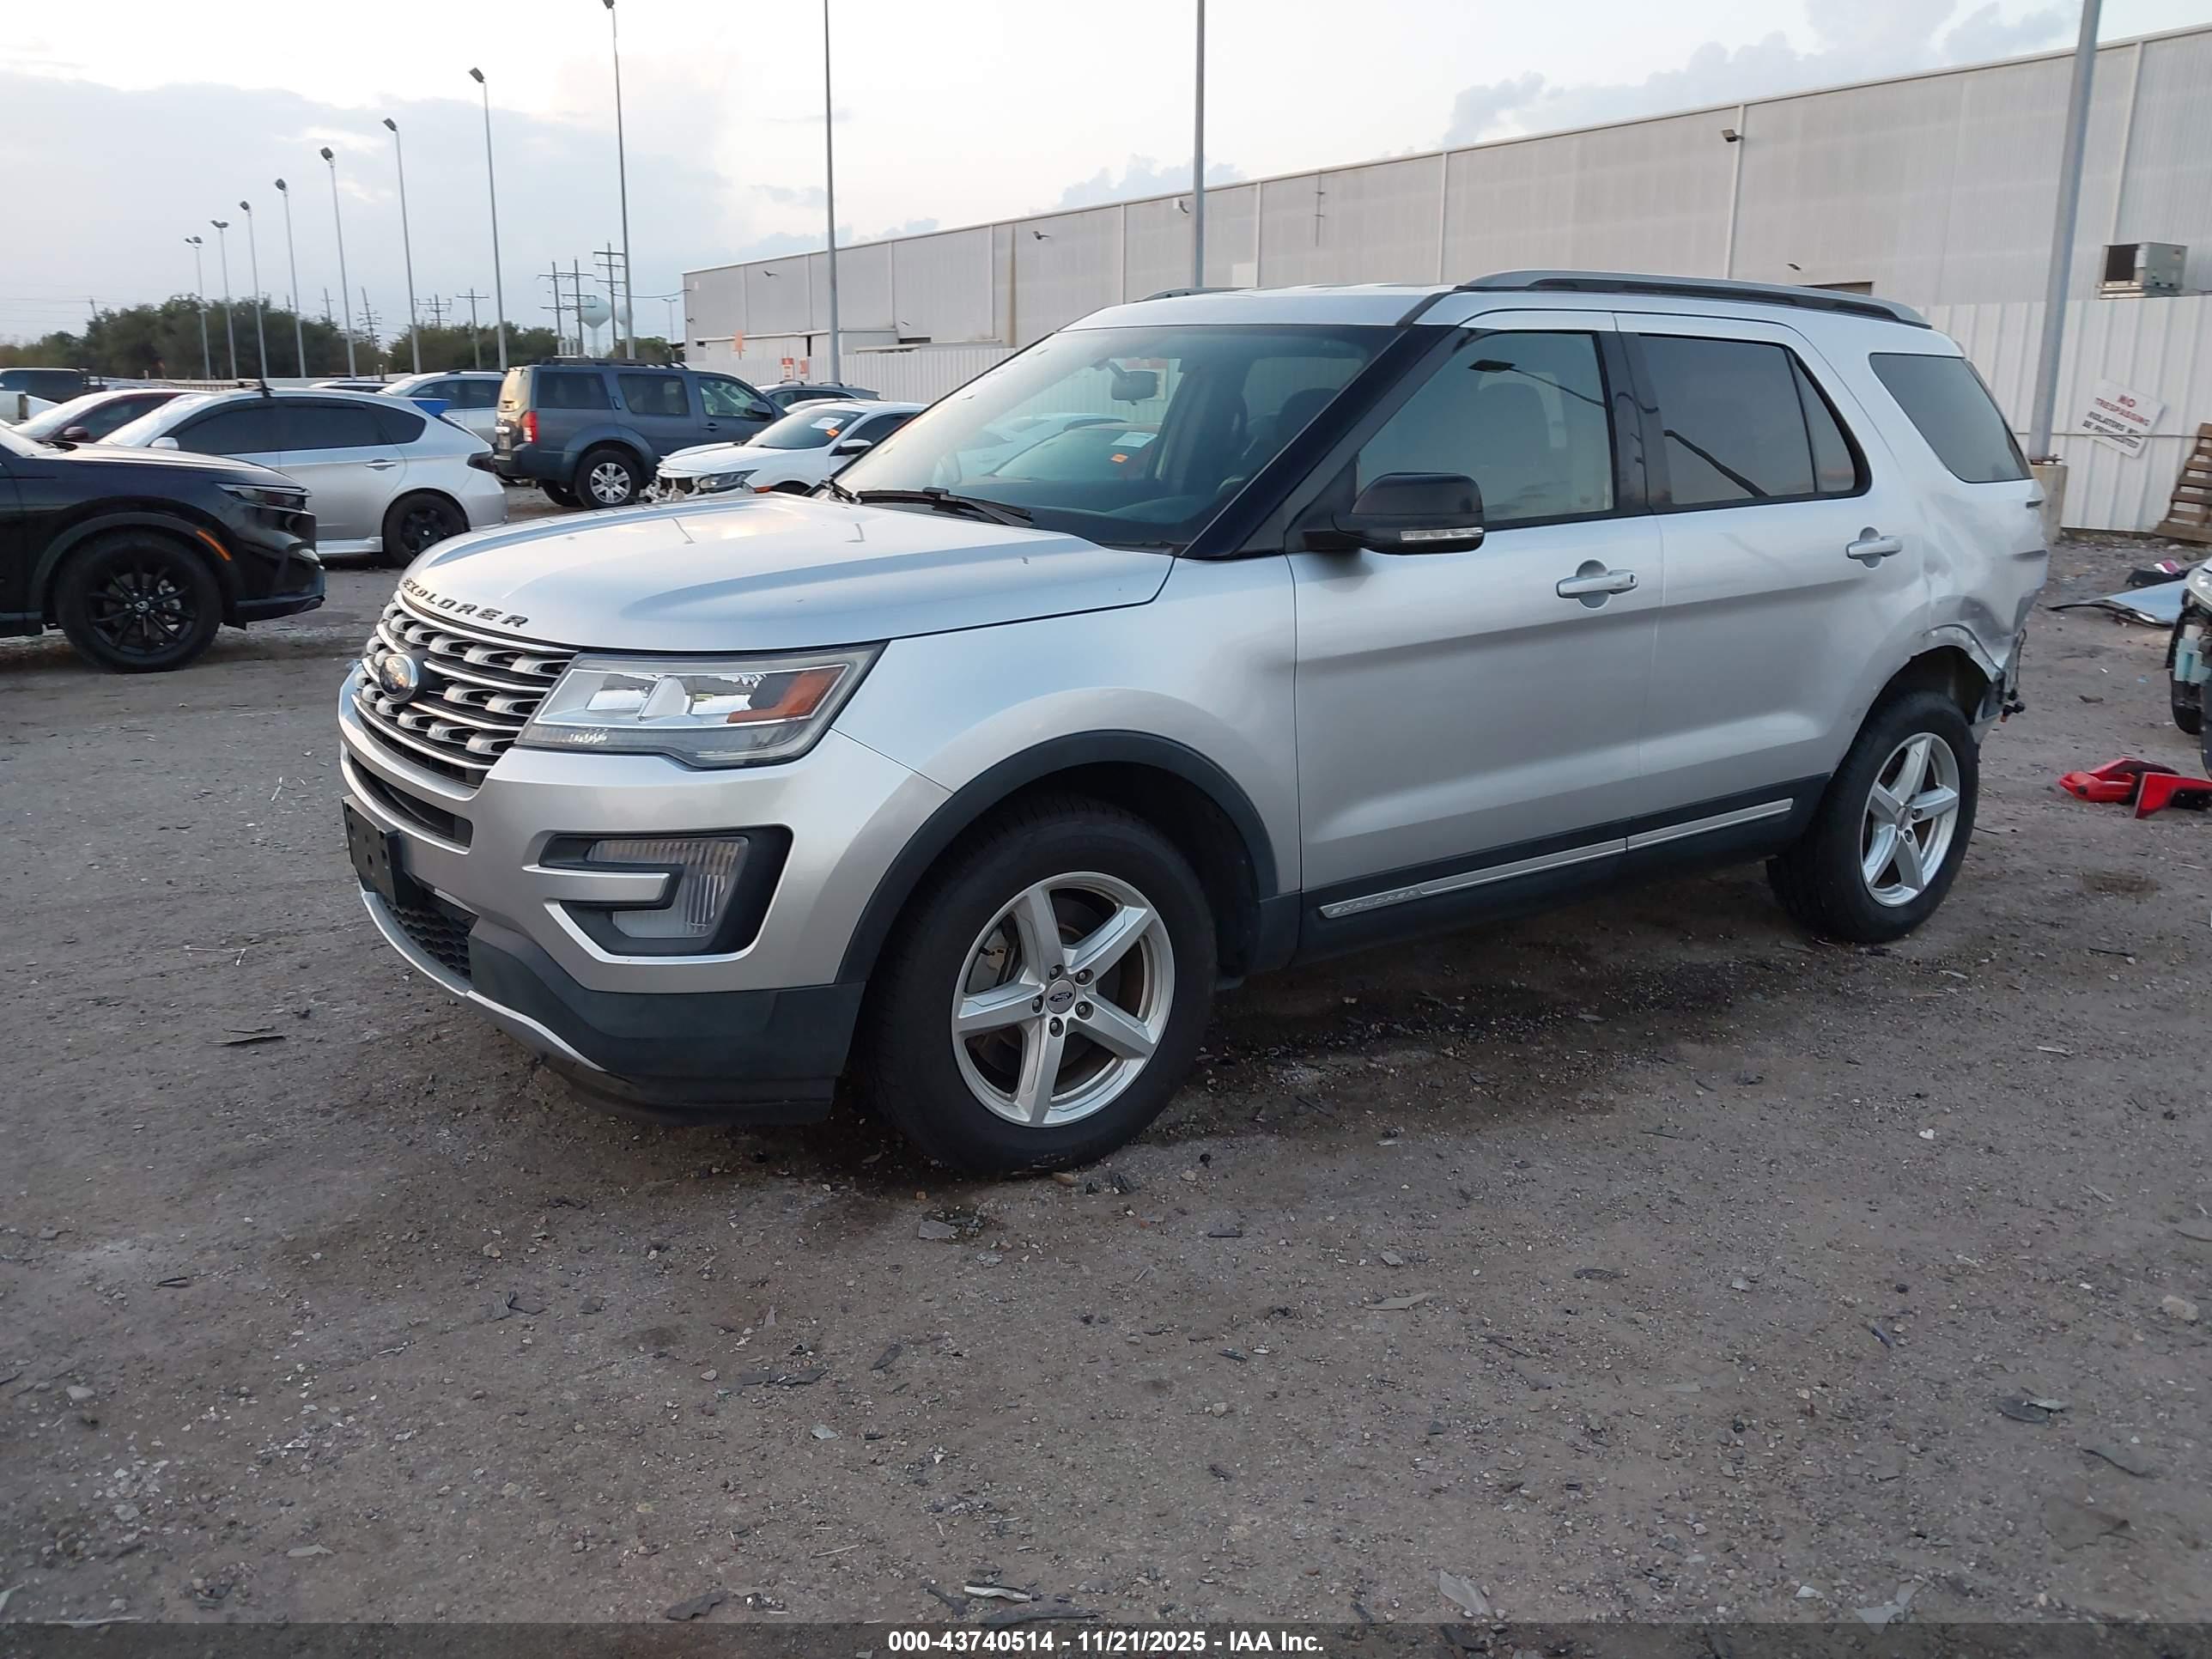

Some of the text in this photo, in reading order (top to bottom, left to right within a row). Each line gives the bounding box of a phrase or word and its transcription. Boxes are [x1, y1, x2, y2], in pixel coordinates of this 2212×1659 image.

[2095, 397, 2151, 427] TRESPASSING
[2118, 394, 2136, 408] NO
[402, 577, 529, 629] EXPLORER
